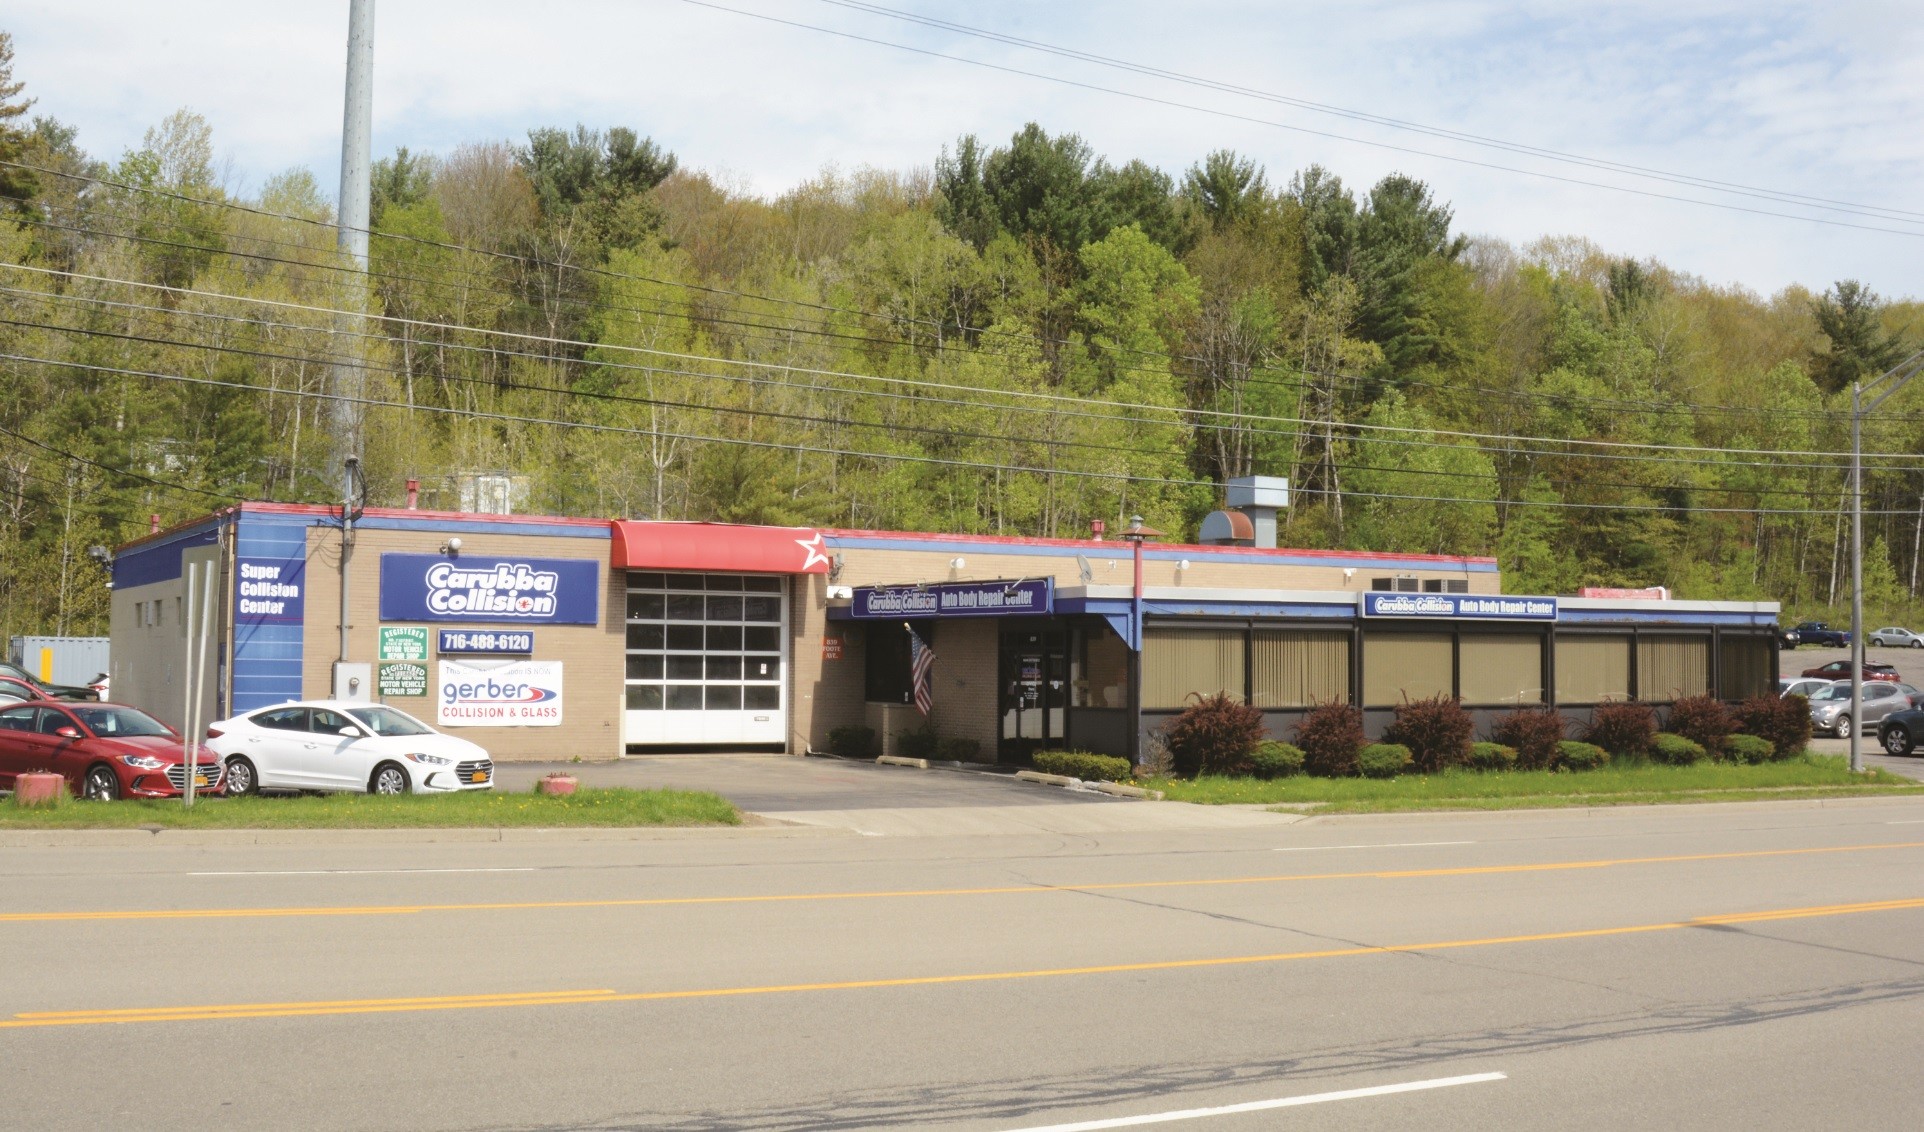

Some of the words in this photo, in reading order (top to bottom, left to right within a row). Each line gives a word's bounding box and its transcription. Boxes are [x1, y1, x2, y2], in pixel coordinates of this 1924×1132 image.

[241, 563, 280, 580] Super
[430, 566, 554, 590] Carubba
[240, 581, 299, 598] Collision
[240, 598, 285, 615] Center
[430, 589, 553, 613] Collision
[868, 591, 901, 613] Carubba
[902, 590, 937, 612] Collision
[941, 591, 957, 607] Auto
[959, 590, 977, 609] Body
[978, 589, 1004, 607] Repair
[1377, 598, 1415, 613] Carubba
[1416, 598, 1453, 613] Collision
[1460, 599, 1479, 612] Auto
[1480, 600, 1499, 614] Body
[1500, 601, 1526, 614] Repair
[1527, 601, 1553, 614] Center
[384, 628, 425, 639] REGISTERED
[444, 633, 530, 650] 716-488-6120
[381, 663, 425, 676] REGISTERED
[380, 680, 400, 688] MOTOR
[401, 680, 426, 688] VEHICLE
[384, 687, 405, 695] REPAIR
[406, 687, 423, 695] SHOP
[443, 678, 529, 705] gerber
[442, 707, 504, 718] COLLISION
[509, 708, 517, 718] &
[521, 707, 558, 718] GLASS
